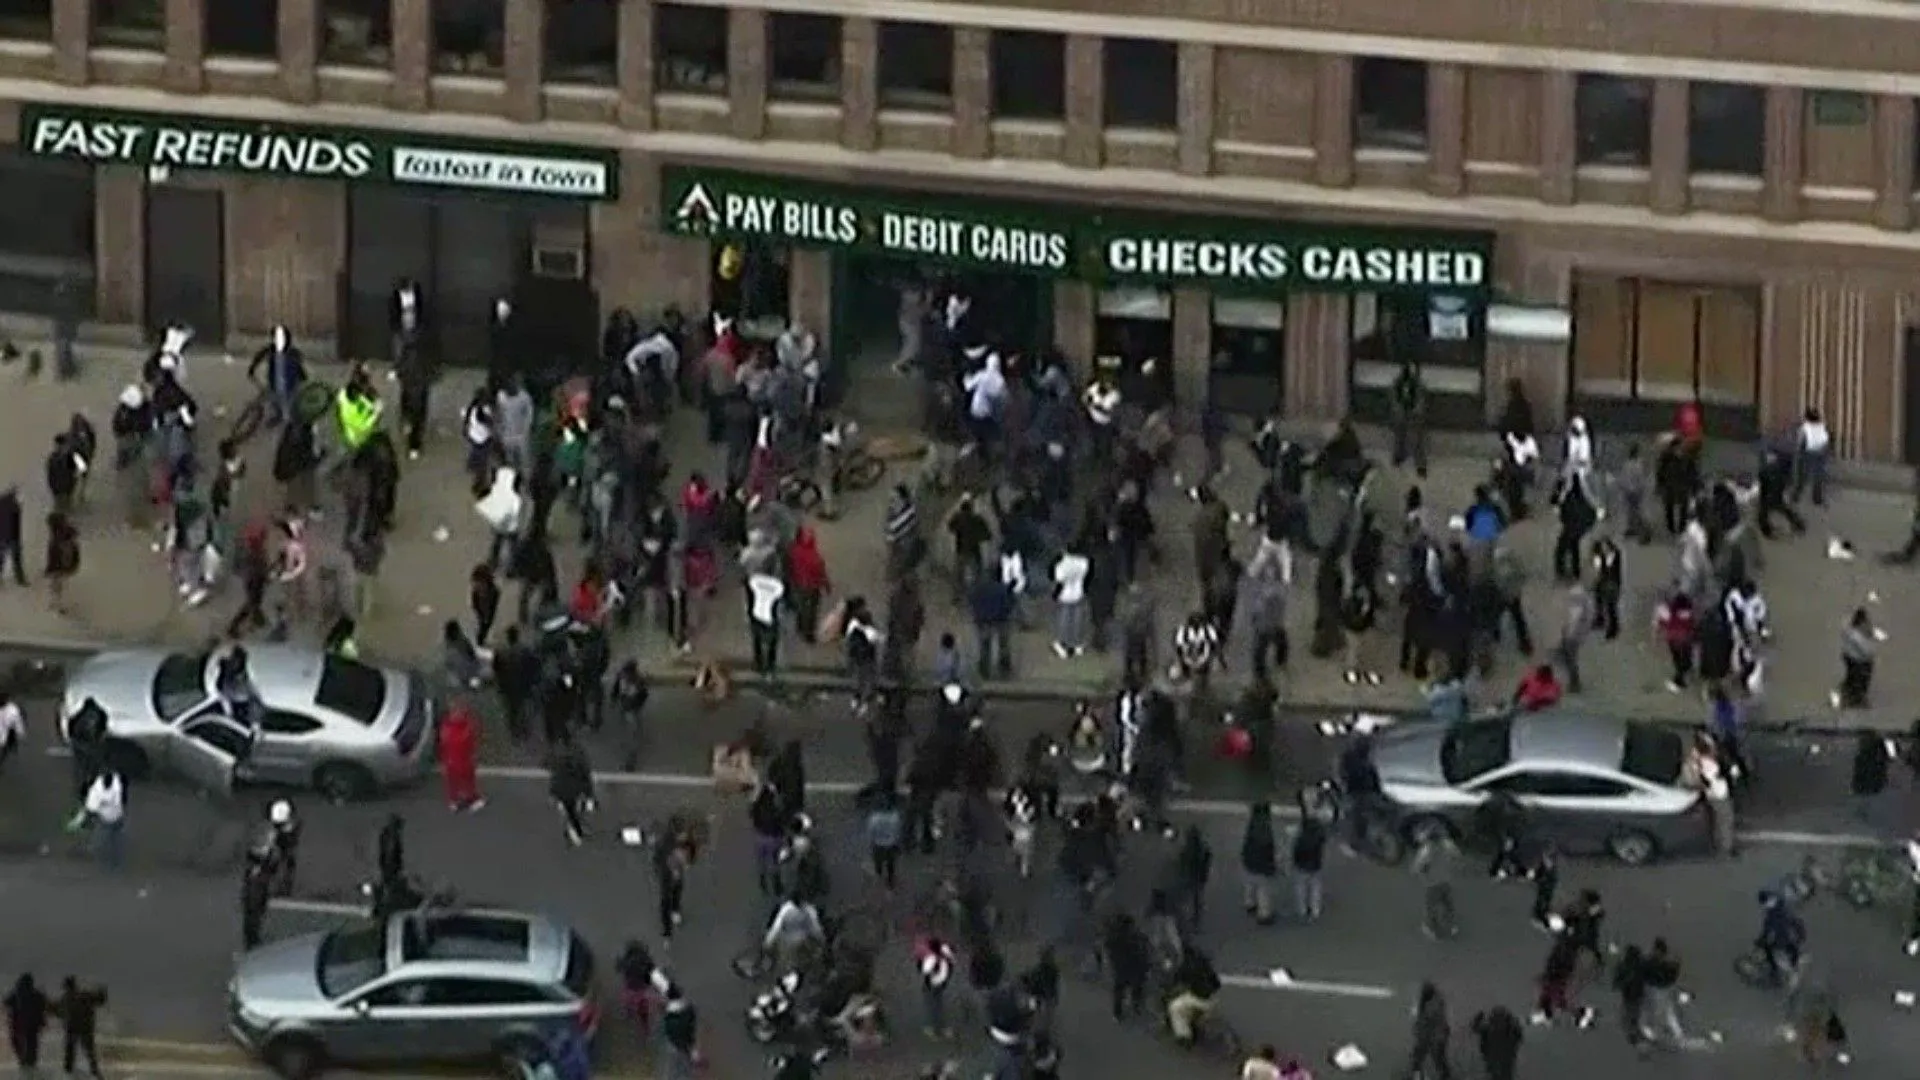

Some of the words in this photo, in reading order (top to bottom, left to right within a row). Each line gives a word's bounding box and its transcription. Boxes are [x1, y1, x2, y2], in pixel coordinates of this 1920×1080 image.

[33, 118, 143, 158] FAST
[154, 129, 372, 177] REFUNDS
[499, 162, 524, 182] in
[531, 165, 598, 188] town
[726, 193, 777, 233] PAY
[783, 201, 857, 243] BILLS
[883, 213, 963, 256] DEBIT
[971, 224, 1067, 268] CARDS
[1109, 239, 1288, 279] CHECKS
[1302, 247, 1484, 285] CASHED
